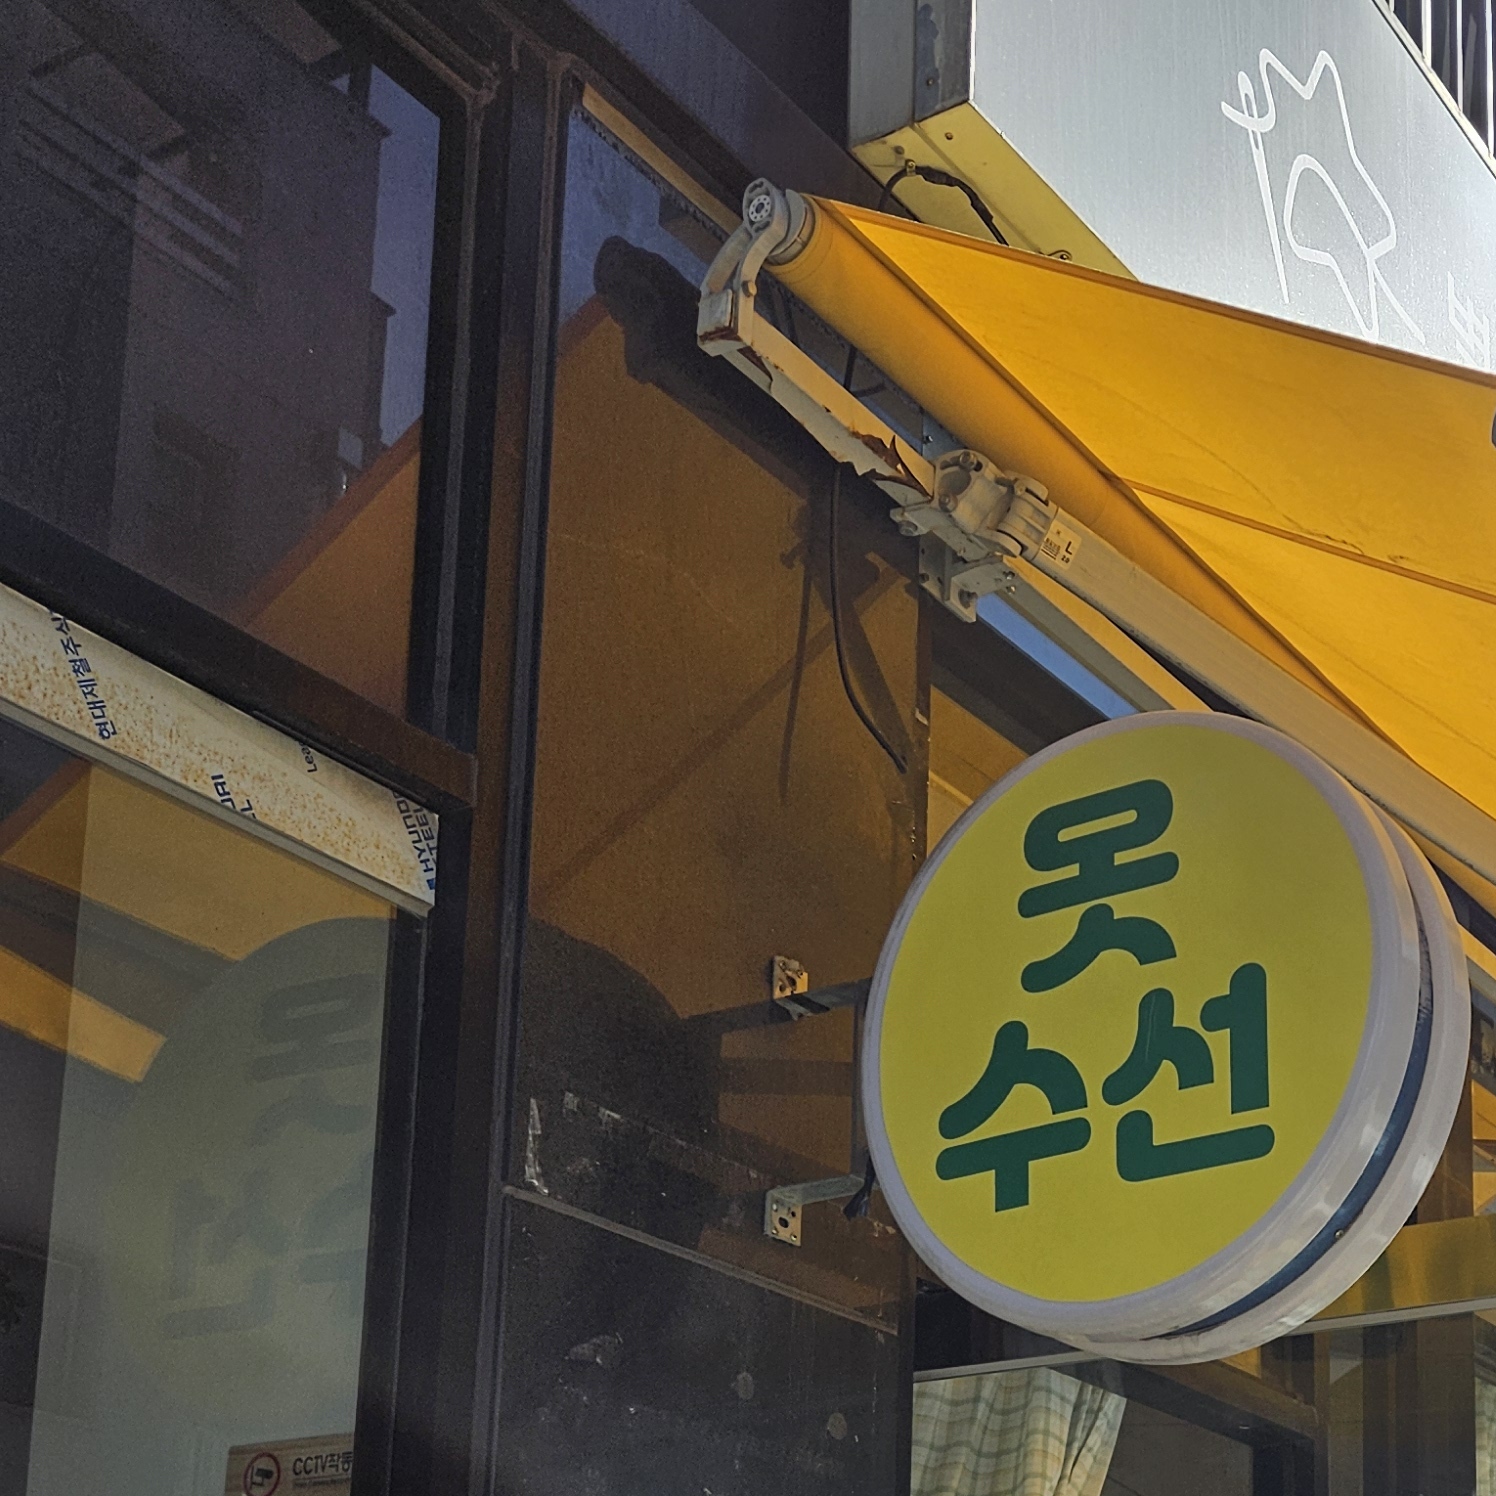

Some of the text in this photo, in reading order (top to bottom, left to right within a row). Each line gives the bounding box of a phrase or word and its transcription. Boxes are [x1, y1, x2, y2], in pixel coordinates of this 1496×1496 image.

[412, 806, 438, 865] TEEL
[1017, 778, 1180, 993] 옷
[935, 962, 1275, 1213] 수선
